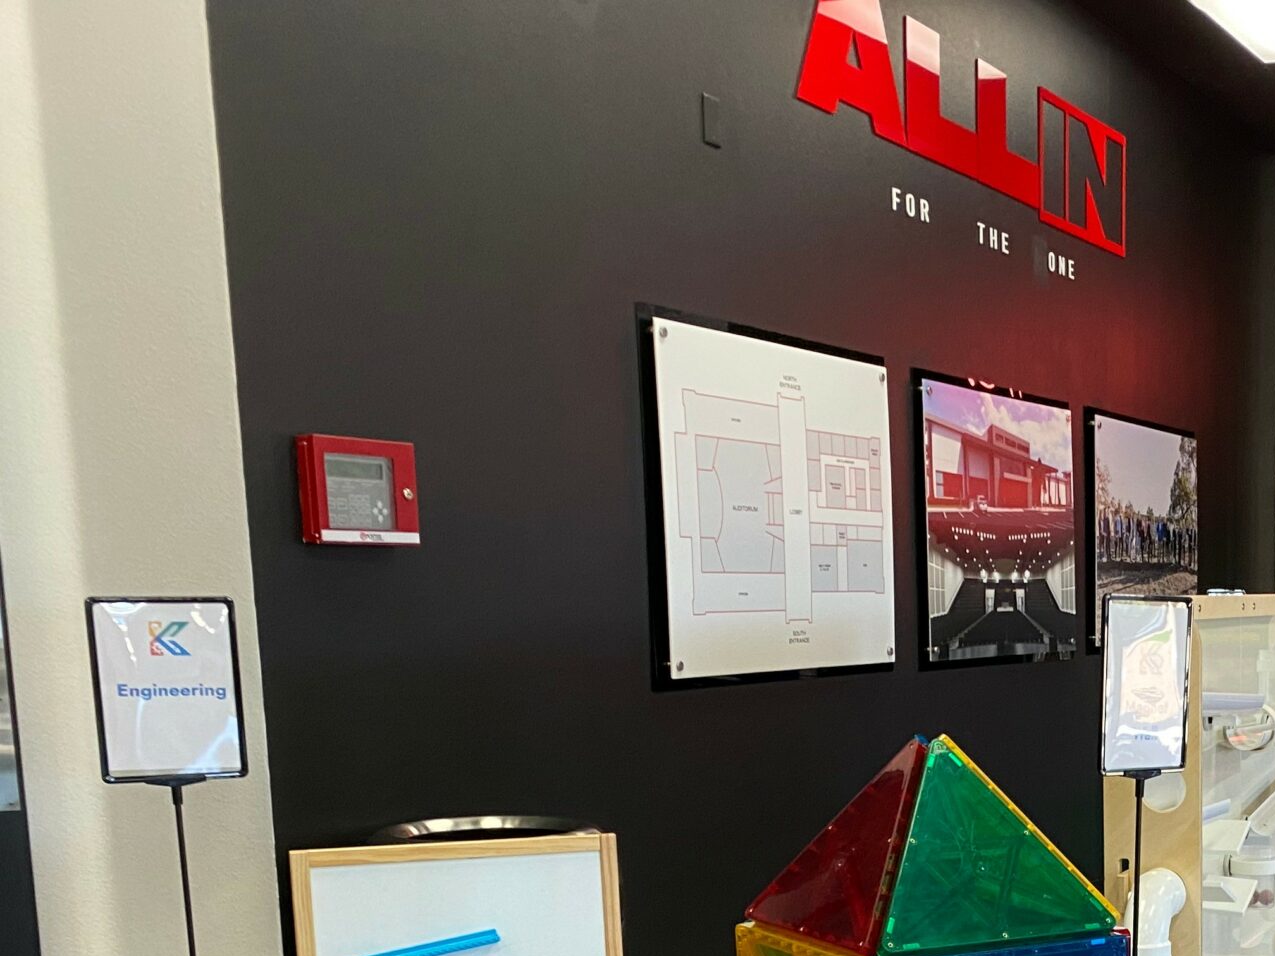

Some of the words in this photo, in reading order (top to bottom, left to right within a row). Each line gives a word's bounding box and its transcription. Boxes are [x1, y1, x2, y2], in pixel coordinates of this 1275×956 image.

[797, 0, 1040, 210] ALL
[1038, 86, 1127, 258] IN
[891, 187, 931, 224] FOR
[977, 222, 1010, 255] THE
[1047, 251, 1076, 280] ONE
[116, 683, 227, 700] Engineering
